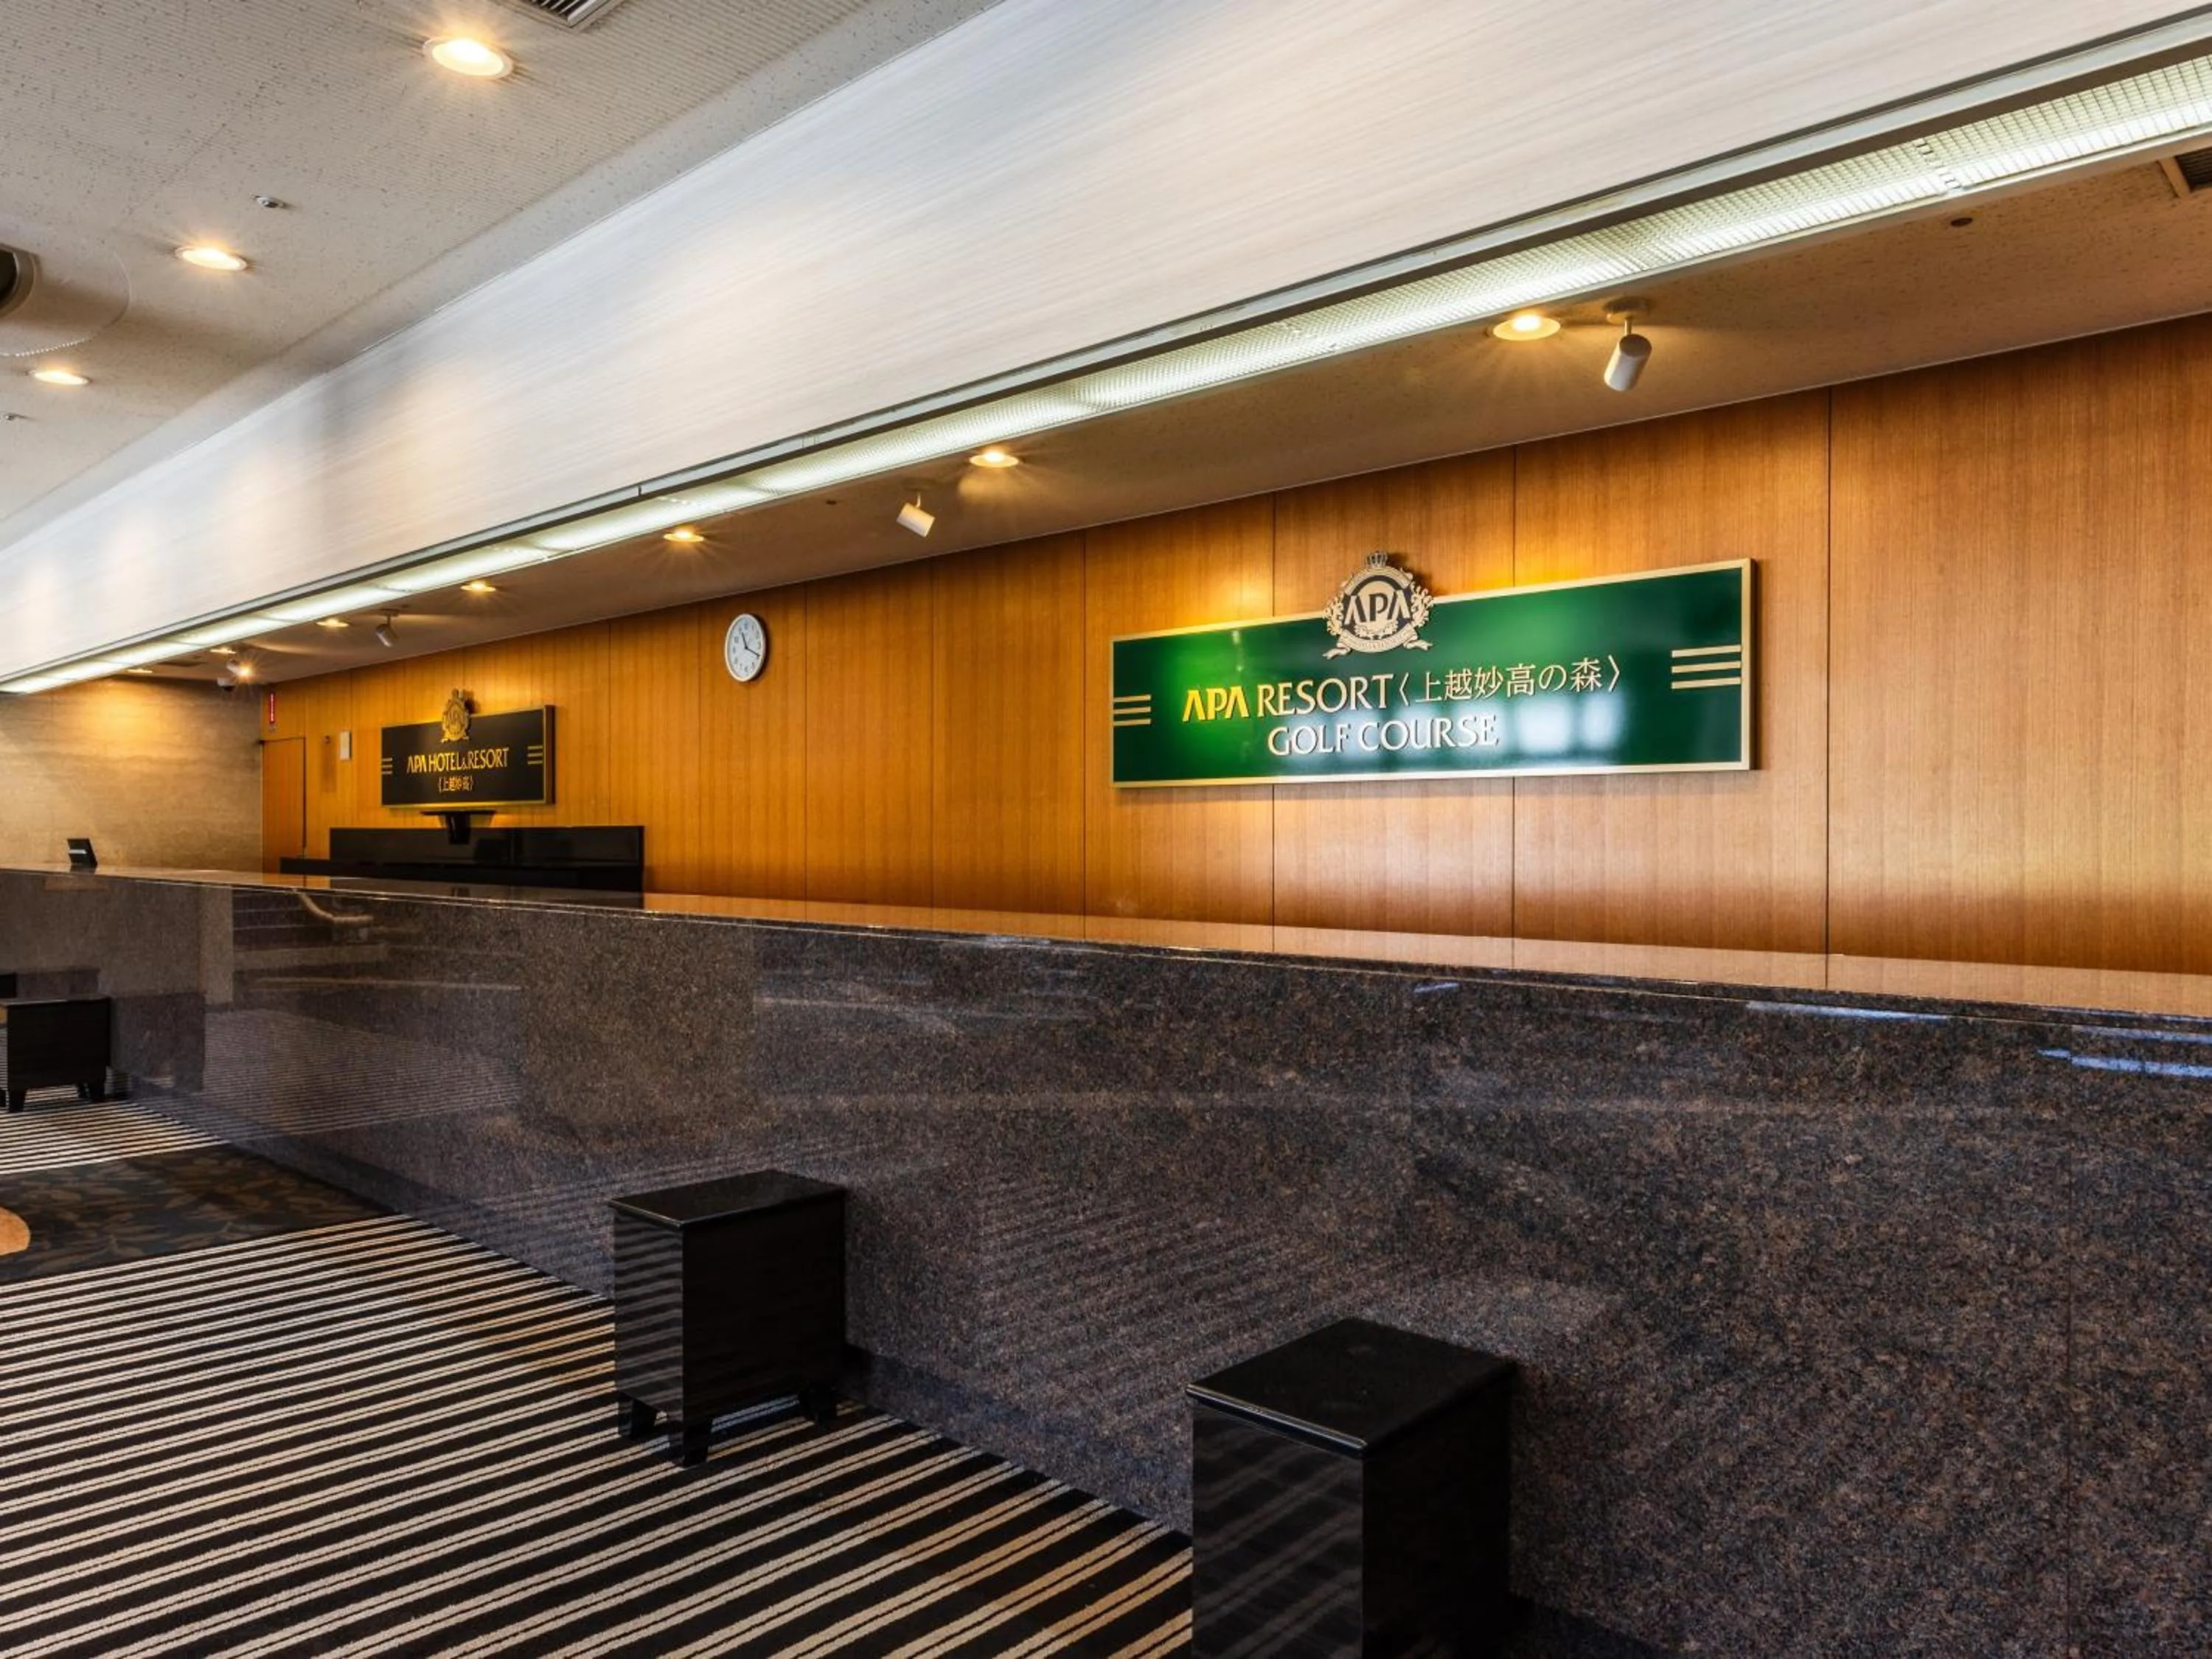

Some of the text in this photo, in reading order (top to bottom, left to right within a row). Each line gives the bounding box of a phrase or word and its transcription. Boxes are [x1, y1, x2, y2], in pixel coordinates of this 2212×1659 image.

[1344, 590, 1411, 625] APA
[1182, 686, 1250, 722] APA
[1257, 674, 1394, 717] RESORT
[1268, 714, 1499, 756] GOLF COURSE
[407, 755, 427, 773] APA
